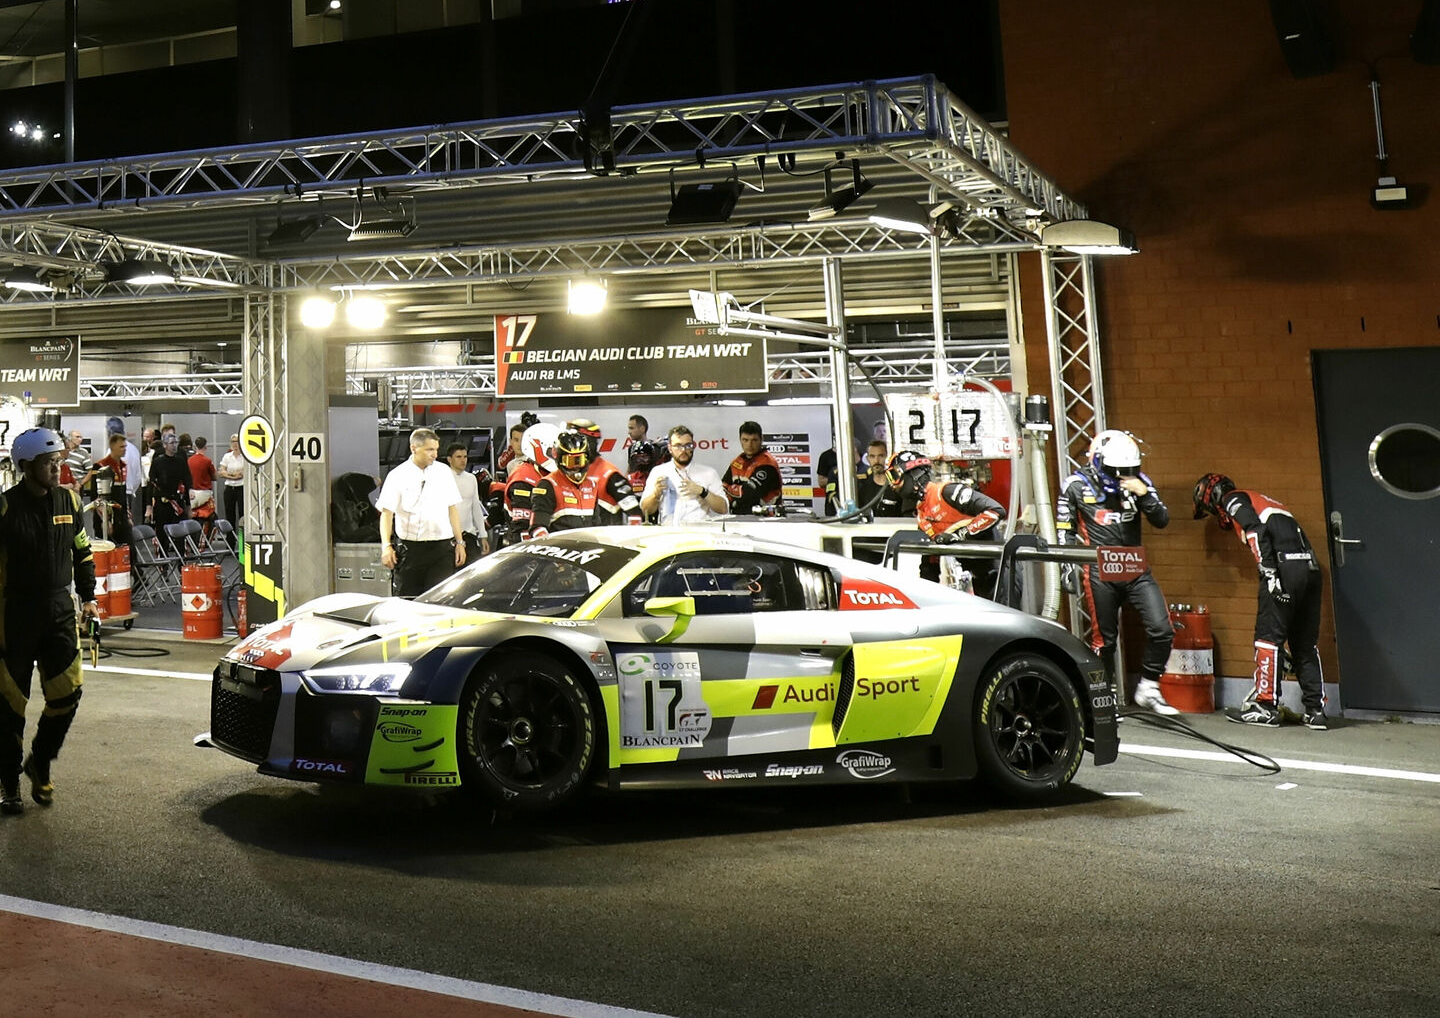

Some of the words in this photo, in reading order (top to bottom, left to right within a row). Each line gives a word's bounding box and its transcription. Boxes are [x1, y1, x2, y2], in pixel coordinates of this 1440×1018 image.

[502, 315, 537, 347] 17
[30, 344, 66, 353] BLANCPAIN
[527, 350, 586, 363] BELGIAN
[589, 347, 624, 361] AUDI
[627, 346, 664, 360] CLUB
[667, 344, 710, 359] TEAM
[713, 342, 752, 357] WRT
[1, 369, 36, 382] TEAM
[36, 368, 71, 382] WRT
[510, 371, 537, 380] AUDI
[539, 370, 554, 380] R8
[557, 369, 581, 380] LMS
[909, 410, 926, 445] 2
[951, 409, 981, 444] 17
[248, 423, 266, 454] 17
[291, 437, 322, 460] 40
[775, 456, 802, 464] OTAL
[255, 544, 273, 565] 17
[1101, 549, 1143, 562] TOTAL
[843, 589, 904, 605] TOTAL
[653, 662, 698, 671] COYOTE
[1258, 656, 1271, 695] TOTAL
[783, 683, 835, 703] Audi
[856, 677, 920, 700] Sport
[981, 671, 1003, 725] PIRELLI
[381, 707, 427, 718] Snap-on
[645, 680, 683, 731] 17
[380, 725, 422, 736] GrafiWrap
[466, 690, 480, 757] PIRELLI
[580, 717, 592, 771] ZERO
[623, 734, 700, 747] BLANCPAIN
[296, 759, 347, 773] TOTAL
[841, 755, 892, 768] GrafiWrap
[404, 771, 457, 785] PIRELLI
[765, 764, 822, 779] Snap-on
